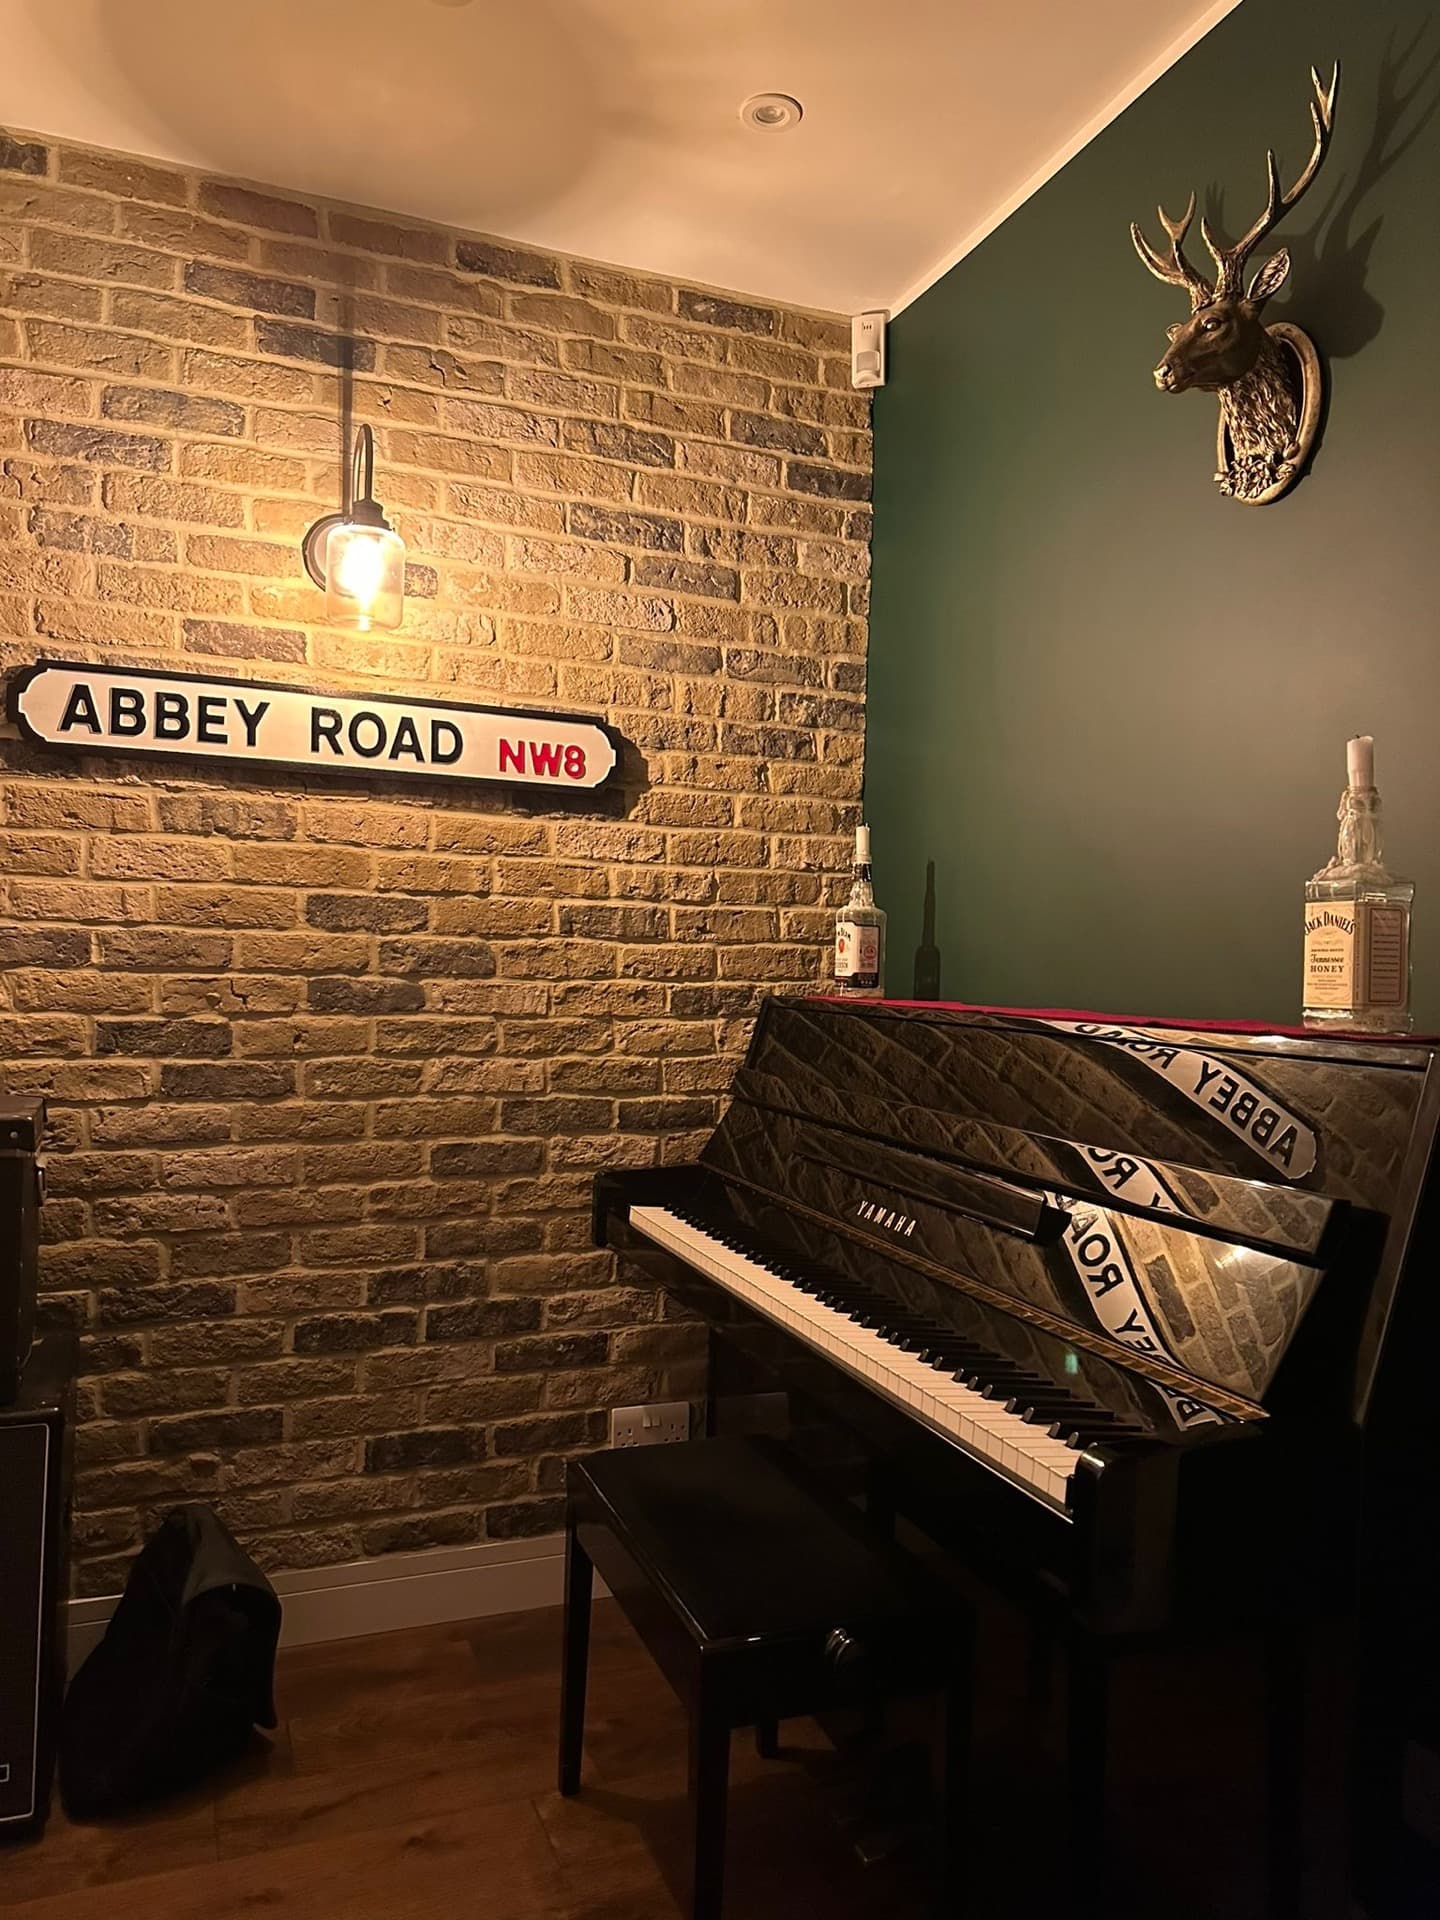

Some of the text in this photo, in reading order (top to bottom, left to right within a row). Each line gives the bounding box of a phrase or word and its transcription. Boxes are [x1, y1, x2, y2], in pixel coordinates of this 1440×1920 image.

[57, 683, 586, 780] ABBEY ROAD NW8
[1304, 917, 1323, 935] JACK
[1310, 965, 1344, 973] HONEY
[857, 1200, 917, 1237] YAMAHA
